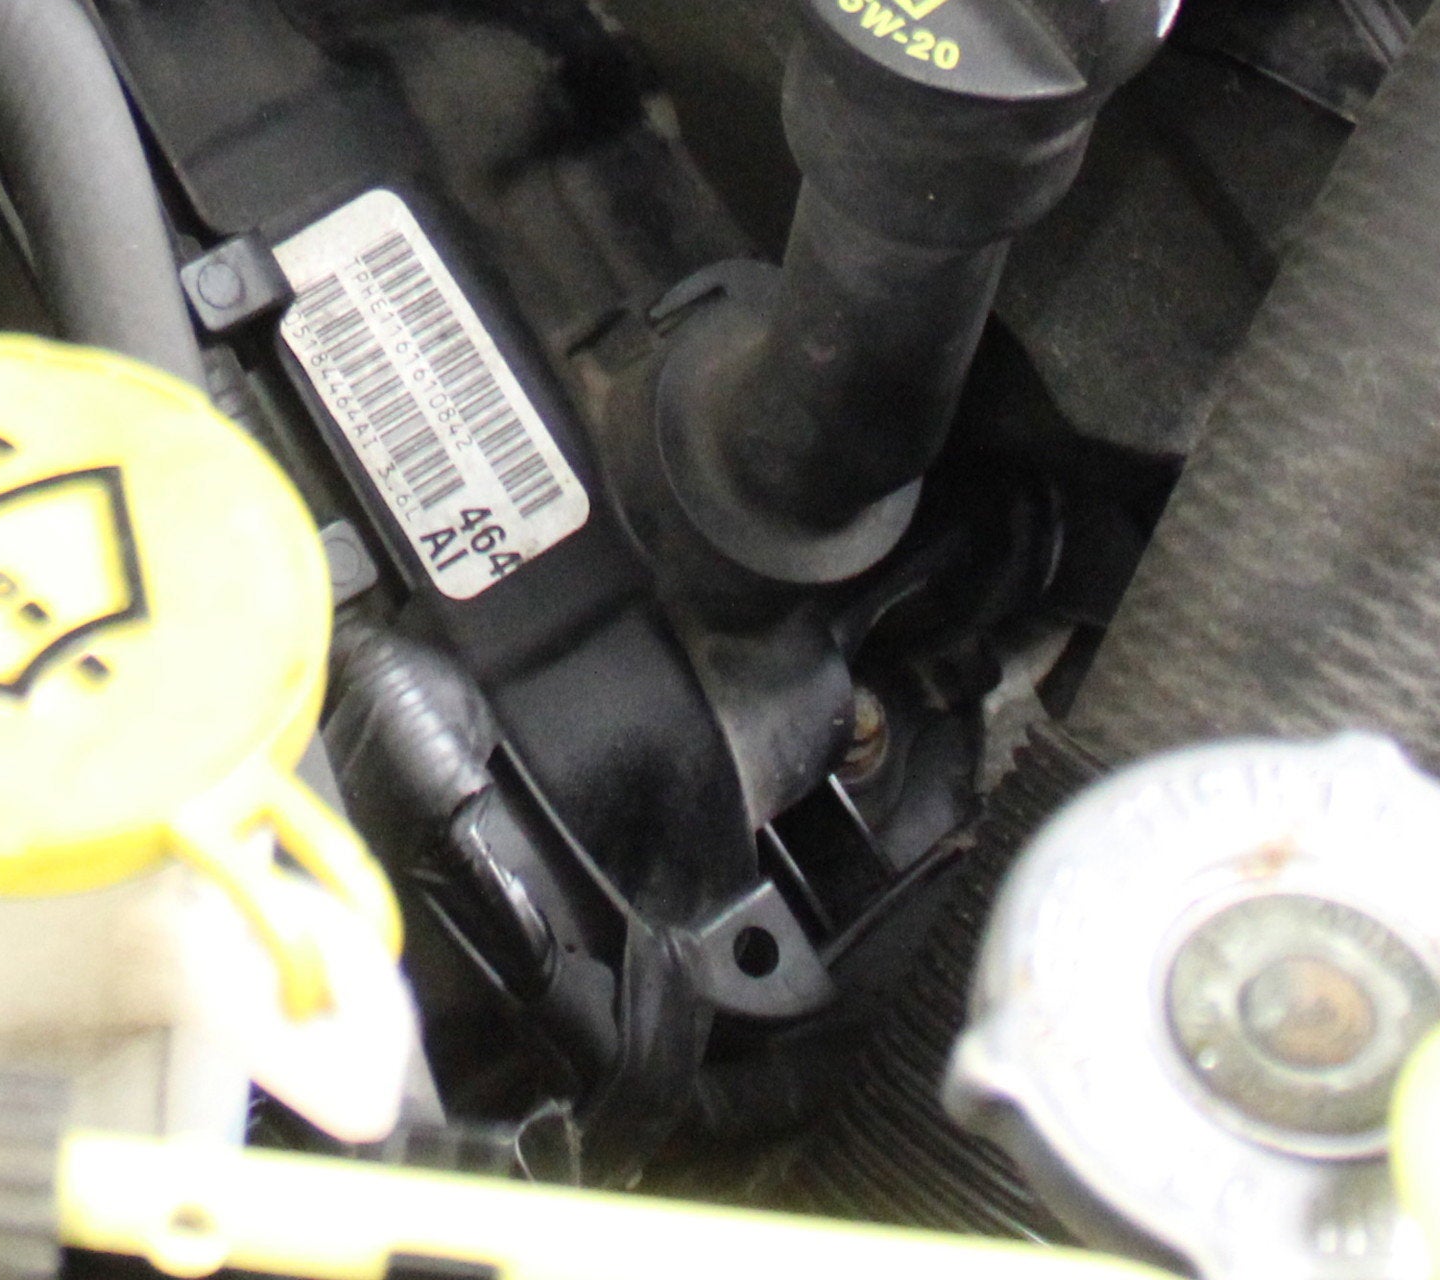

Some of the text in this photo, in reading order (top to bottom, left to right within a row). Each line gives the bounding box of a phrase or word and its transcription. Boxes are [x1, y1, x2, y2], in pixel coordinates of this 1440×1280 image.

[344, 255, 474, 452] TPHE1161610842
[377, 459, 423, 523] 3.6L
[420, 527, 468, 573] AI
[459, 507, 522, 578] 464
